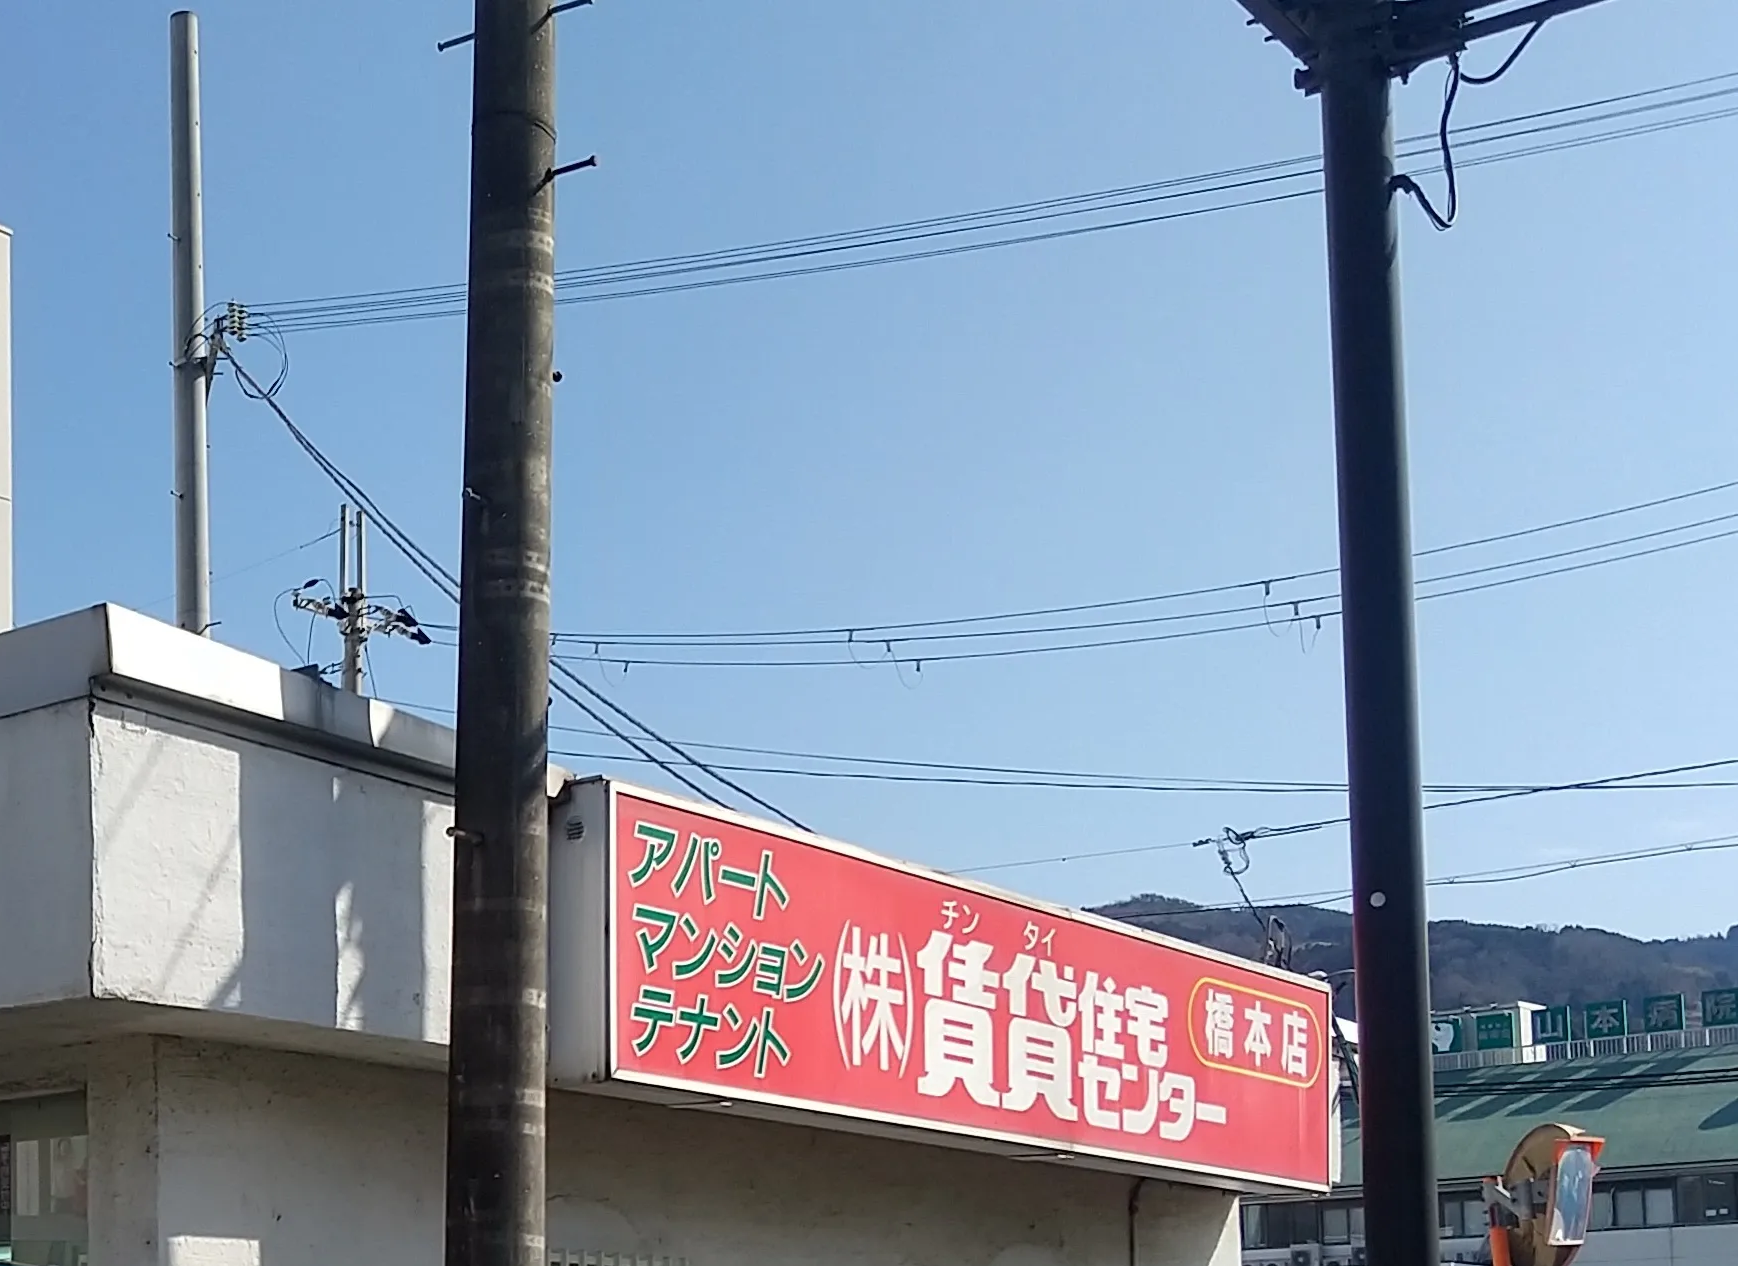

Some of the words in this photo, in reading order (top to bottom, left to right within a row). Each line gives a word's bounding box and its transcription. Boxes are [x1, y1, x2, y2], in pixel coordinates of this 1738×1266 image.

[628, 820, 790, 920] アパート
[632, 903, 825, 1002] マンション
[629, 985, 791, 1078] テナント
[1205, 987, 1309, 1078] 橋本店
[1534, 992, 1738, 1041] 山本病院
